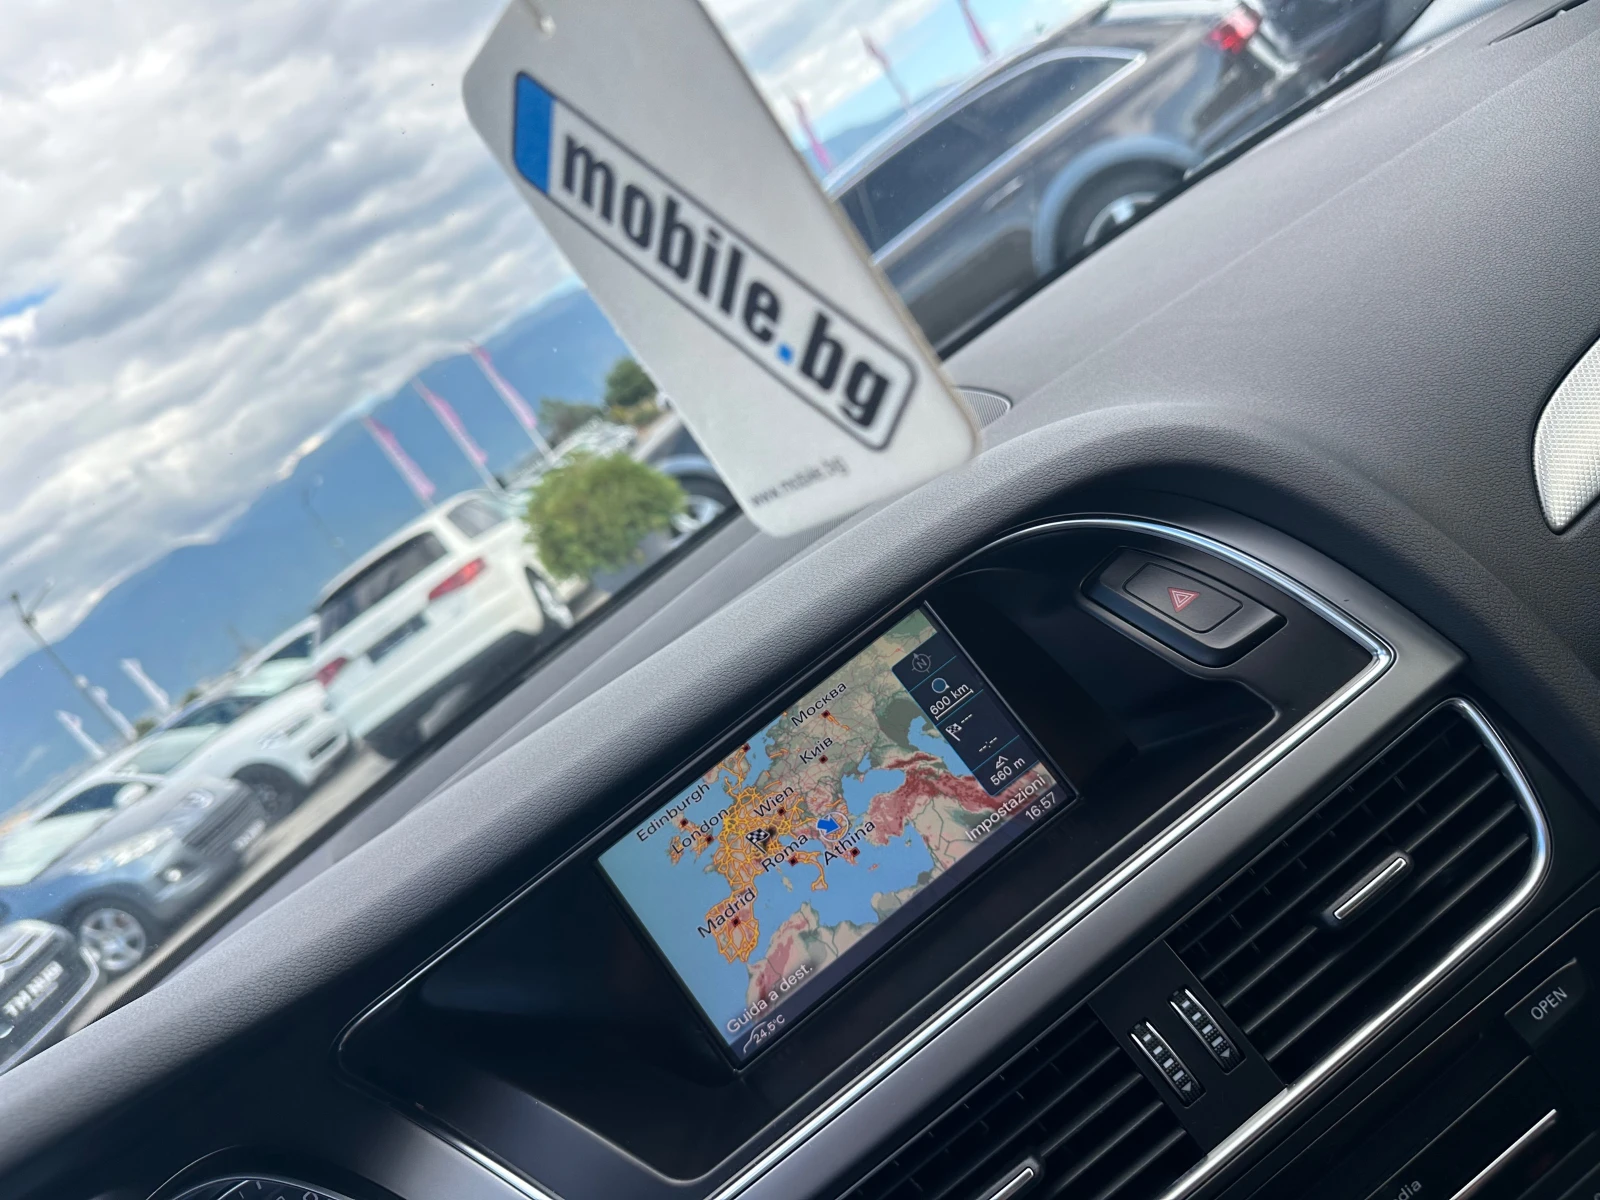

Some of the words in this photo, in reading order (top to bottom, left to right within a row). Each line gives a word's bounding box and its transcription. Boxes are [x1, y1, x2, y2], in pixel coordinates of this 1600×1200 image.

[562, 132, 891, 430] mobile.bg
[790, 682, 847, 727] Москва
[929, 695, 951, 716] 600
[950, 683, 970, 701] km
[990, 765, 1013, 787] 560
[1013, 757, 1026, 770] m
[635, 782, 710, 843] Edinburgh
[753, 784, 795, 818] Wien
[964, 773, 1046, 841] Impostazioni
[1025, 791, 1056, 820] 16:57
[671, 808, 730, 855] London
[760, 834, 809, 873] Roma
[823, 820, 876, 866] Athina
[697, 887, 756, 938] Madrid
[726, 999, 768, 1034] Guida
[768, 990, 779, 1001] a
[779, 963, 813, 992] dest.
[1530, 986, 1568, 1020] OPEN
[1393, 1180, 1422, 1200] dia
